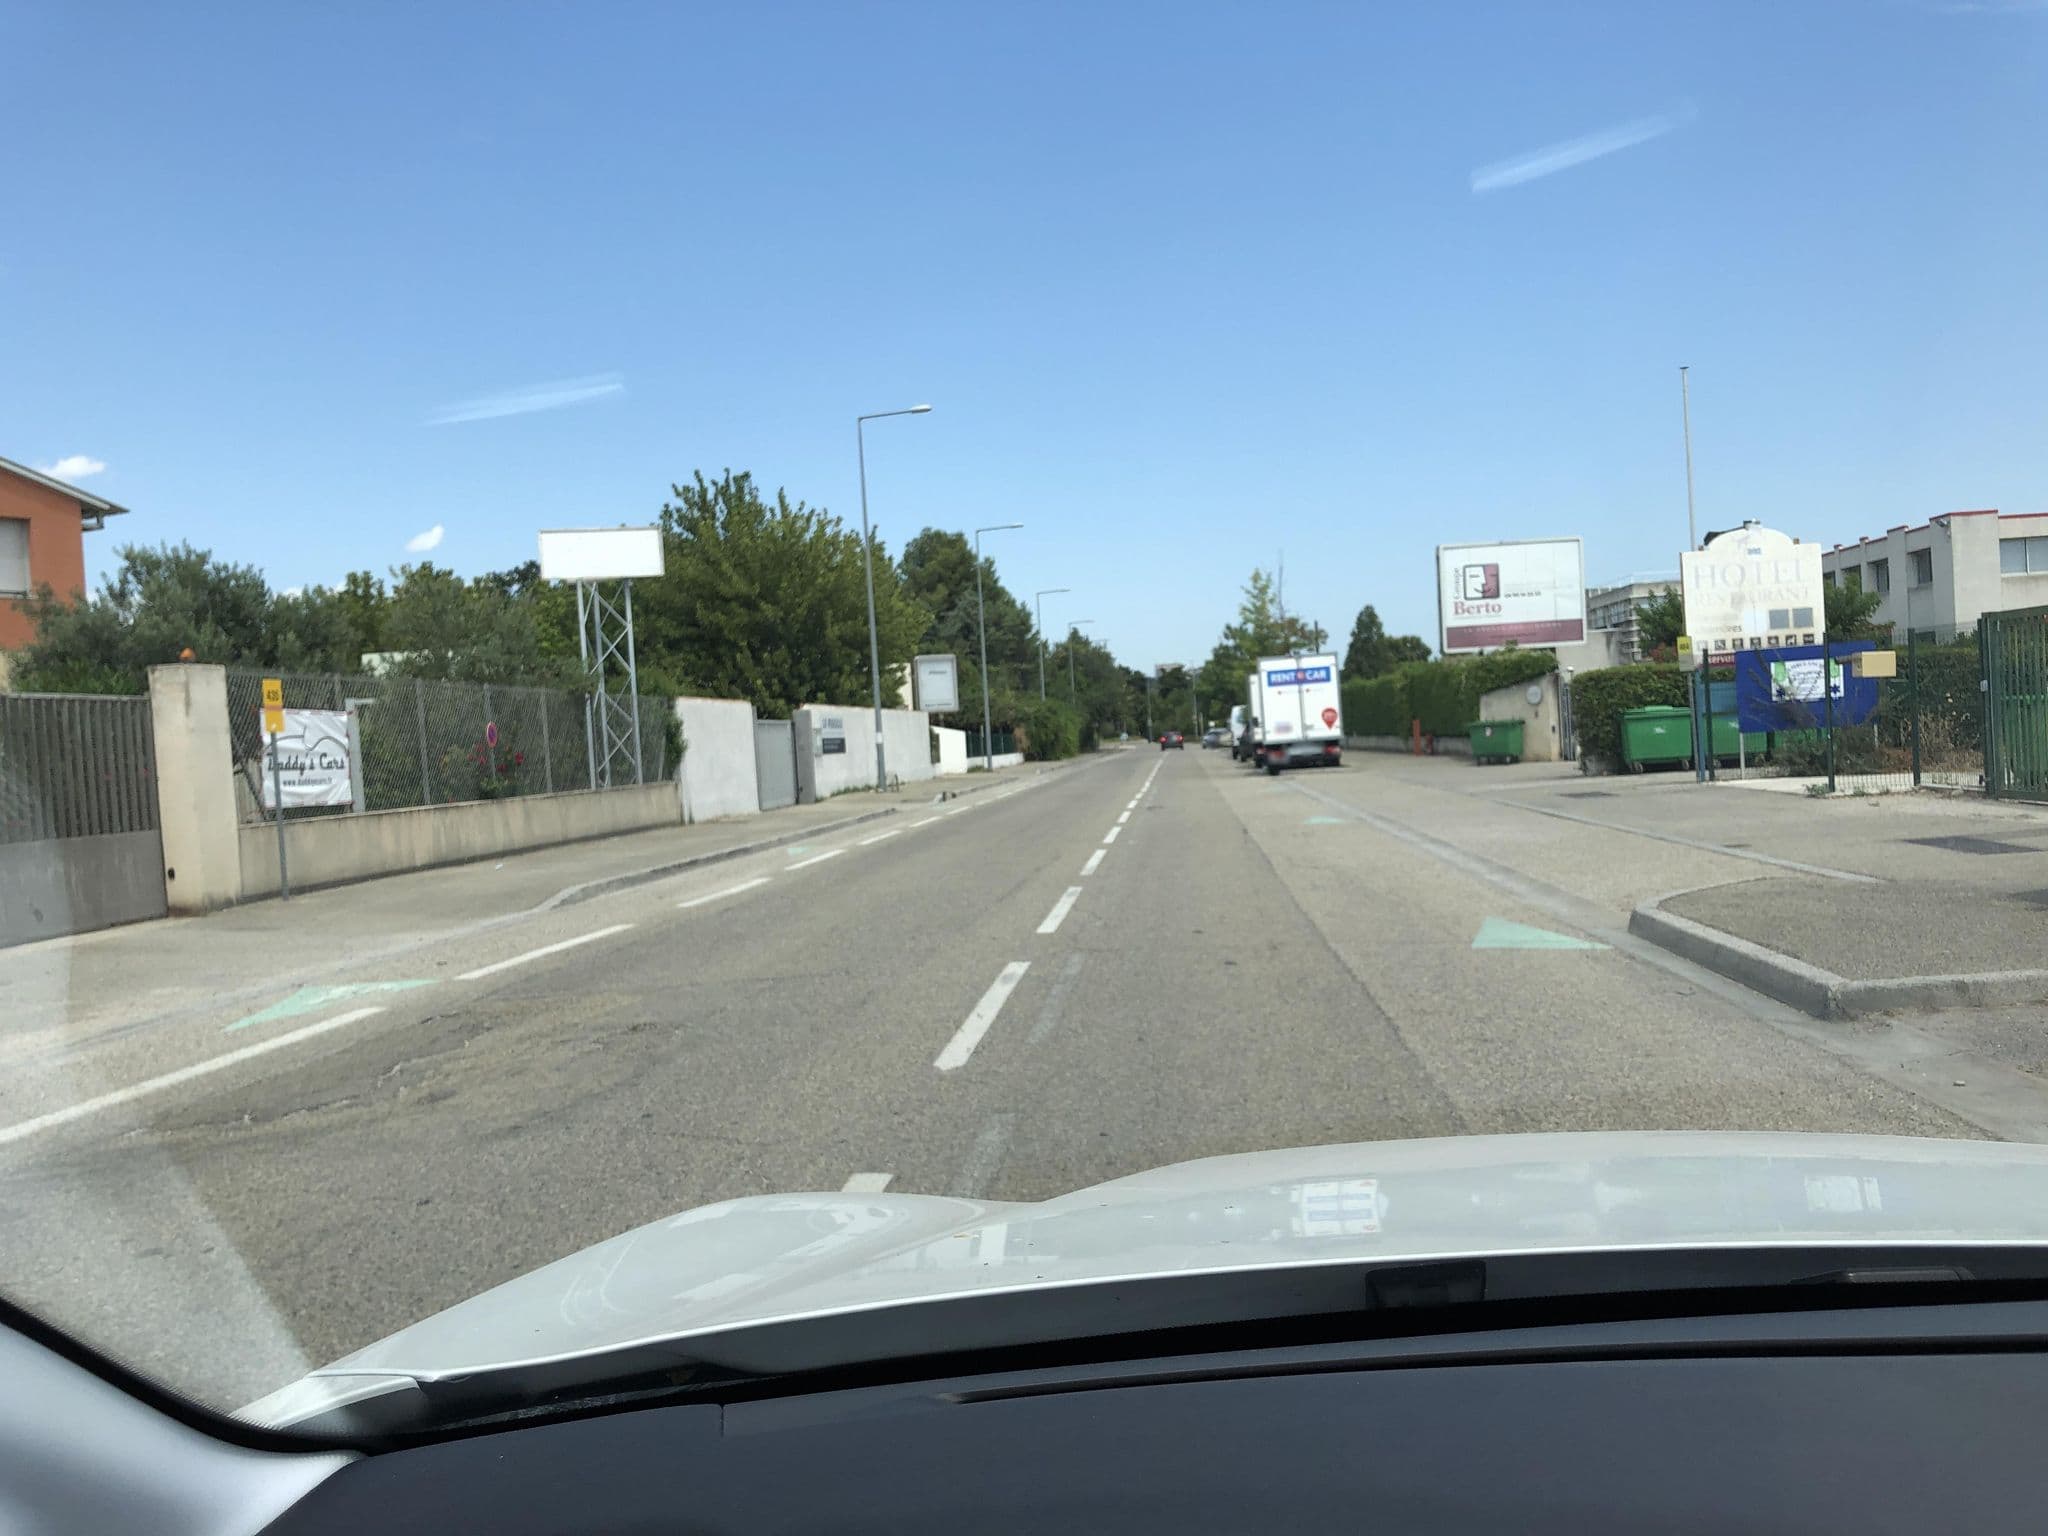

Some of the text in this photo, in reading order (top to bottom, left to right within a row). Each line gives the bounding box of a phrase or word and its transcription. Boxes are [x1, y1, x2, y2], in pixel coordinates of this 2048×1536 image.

[1694, 560, 1804, 589] HOTEL
[1453, 601, 1502, 616] Berto
[1270, 671, 1295, 684] RENT
[1305, 669, 1327, 681] CAR
[319, 752, 345, 770] Cars
